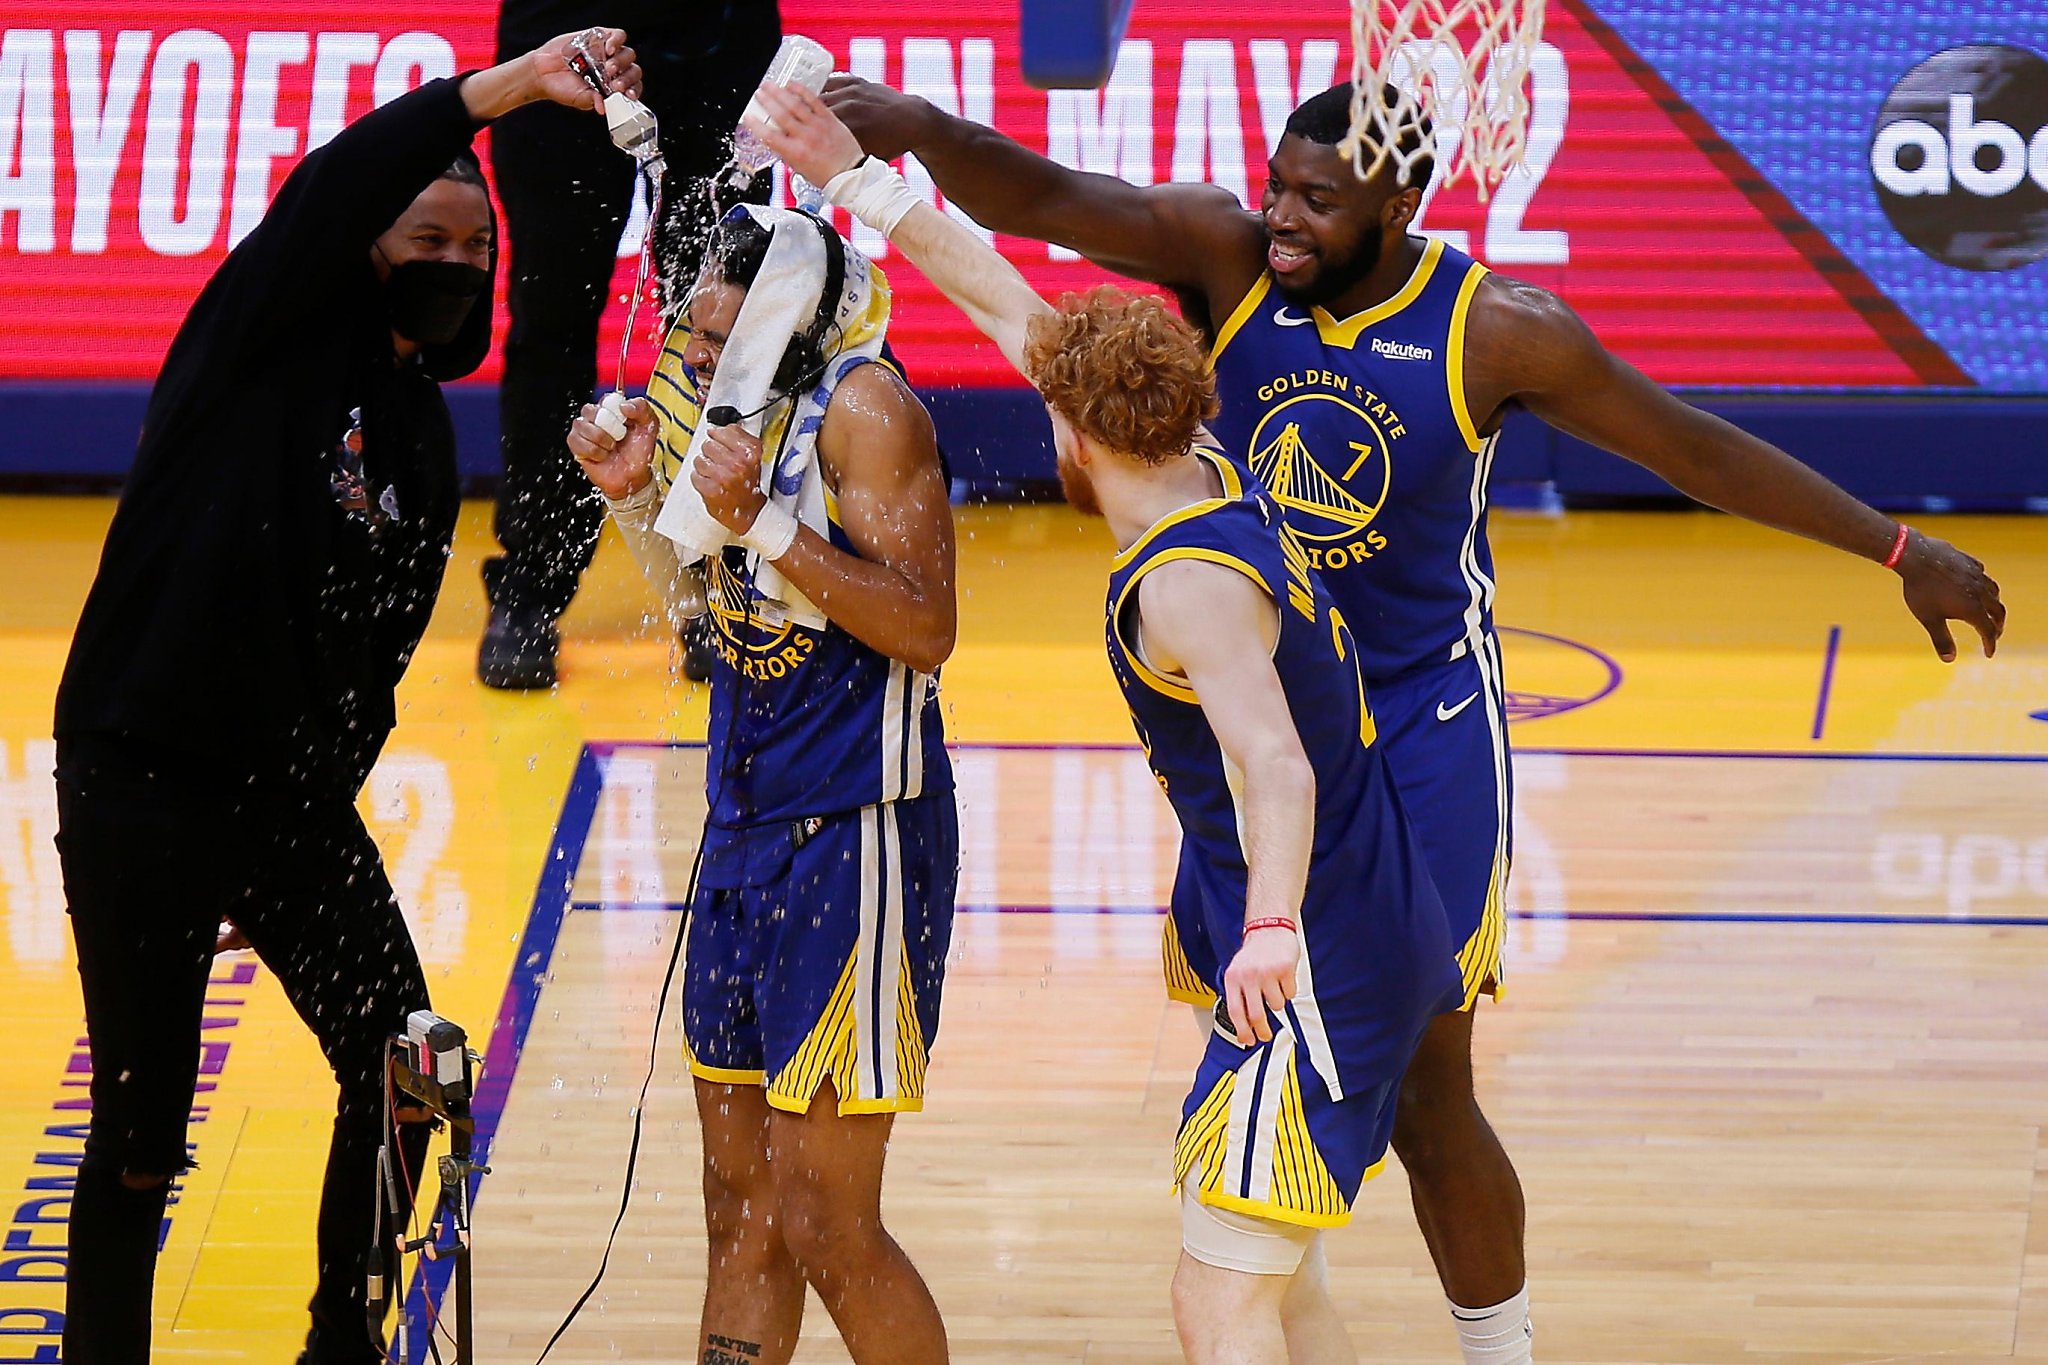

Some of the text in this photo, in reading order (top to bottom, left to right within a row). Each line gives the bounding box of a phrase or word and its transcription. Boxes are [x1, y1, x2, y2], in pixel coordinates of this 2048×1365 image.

[1870, 92, 2048, 197] ab
[1371, 338, 1433, 360] Rakuten
[1257, 369, 1407, 440] GOLDEN STATE
[1341, 440, 1372, 481] 7
[712, 631, 814, 680] ARRIORS
